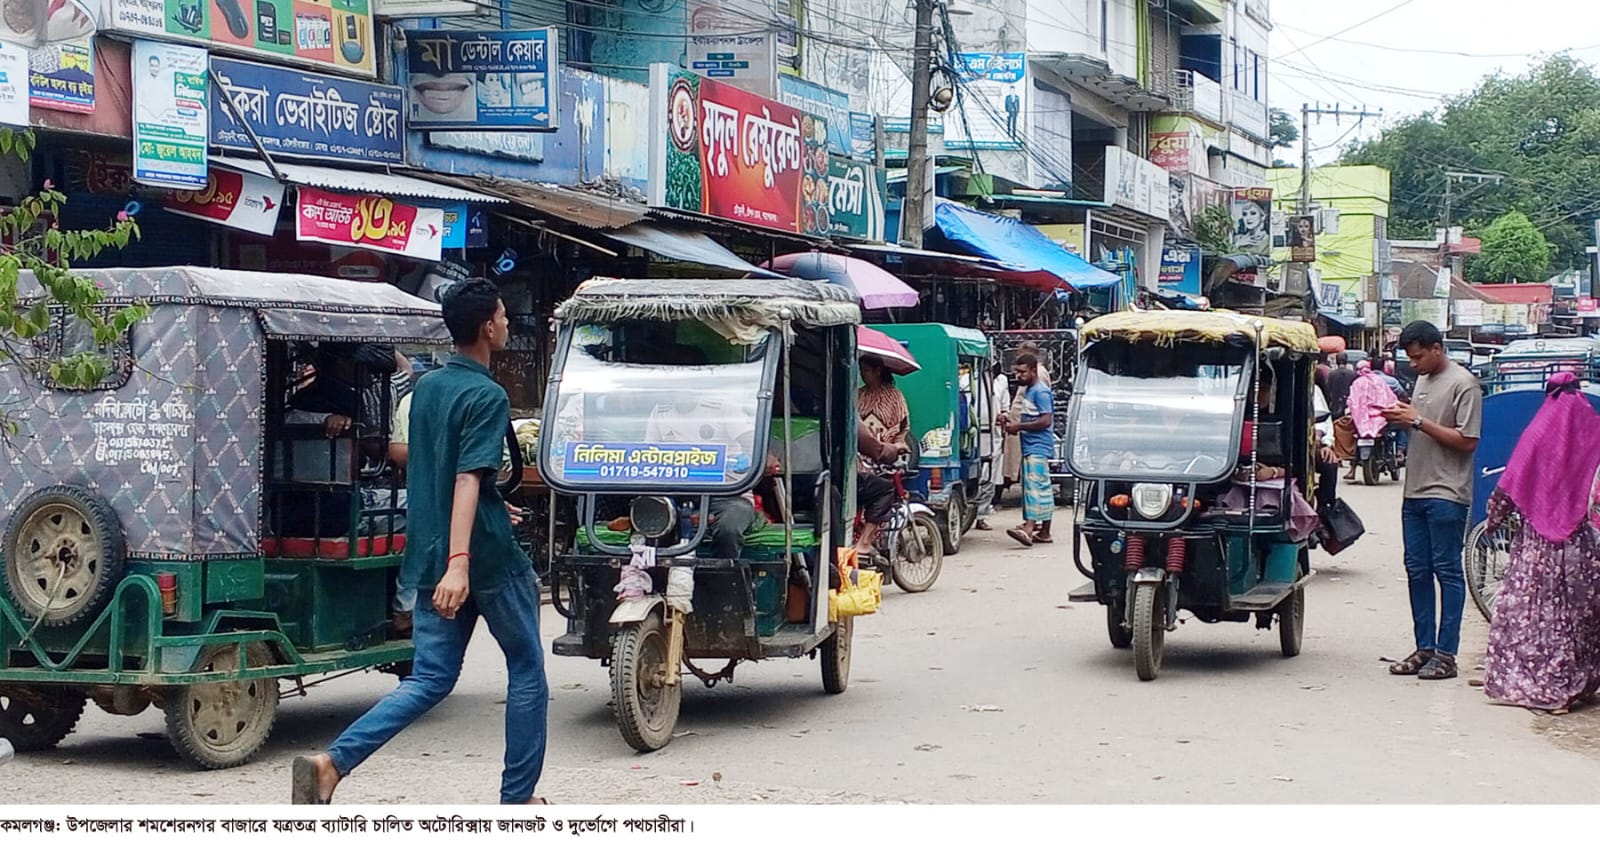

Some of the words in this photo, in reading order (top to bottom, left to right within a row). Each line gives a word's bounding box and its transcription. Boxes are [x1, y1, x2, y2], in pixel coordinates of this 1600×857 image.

[416, 34, 457, 71] মা
[461, 36, 503, 63] ডেন্টাল
[506, 37, 545, 62] কেয়ার
[275, 87, 360, 138] ভেরাইটিজ
[702, 100, 739, 177] মৃদুল
[573, 444, 626, 464] নিলিমা
[628, 446, 718, 466] এন্টারপ্রাইজ
[600, 466, 689, 478] 01719-547910
